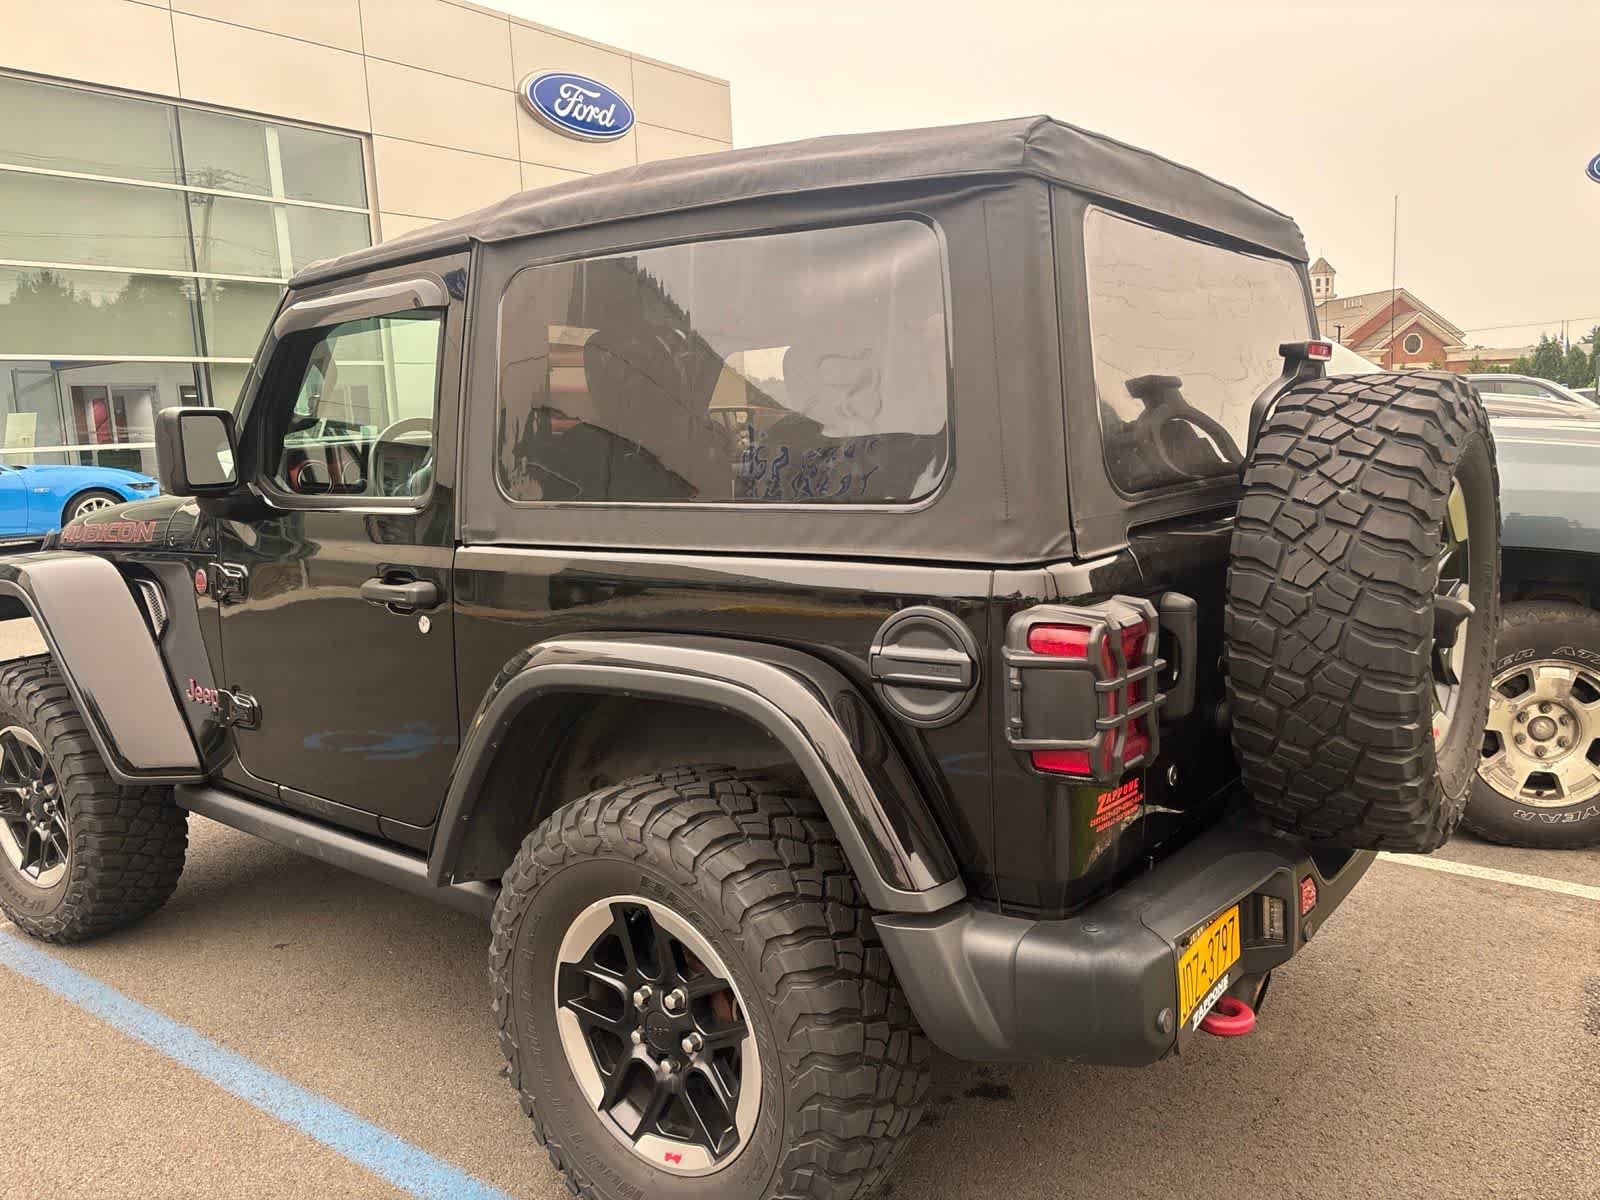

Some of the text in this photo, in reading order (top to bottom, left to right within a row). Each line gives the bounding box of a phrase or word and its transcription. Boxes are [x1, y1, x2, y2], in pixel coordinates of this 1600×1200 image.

[554, 83, 616, 127] Ford
[61, 519, 157, 543] RUBICON
[185, 678, 220, 712] Jeep
[1096, 777, 1139, 815] ZAPPONE
[1208, 916, 1235, 984] 3797
[1192, 973, 1229, 1032] ZAPPONE
